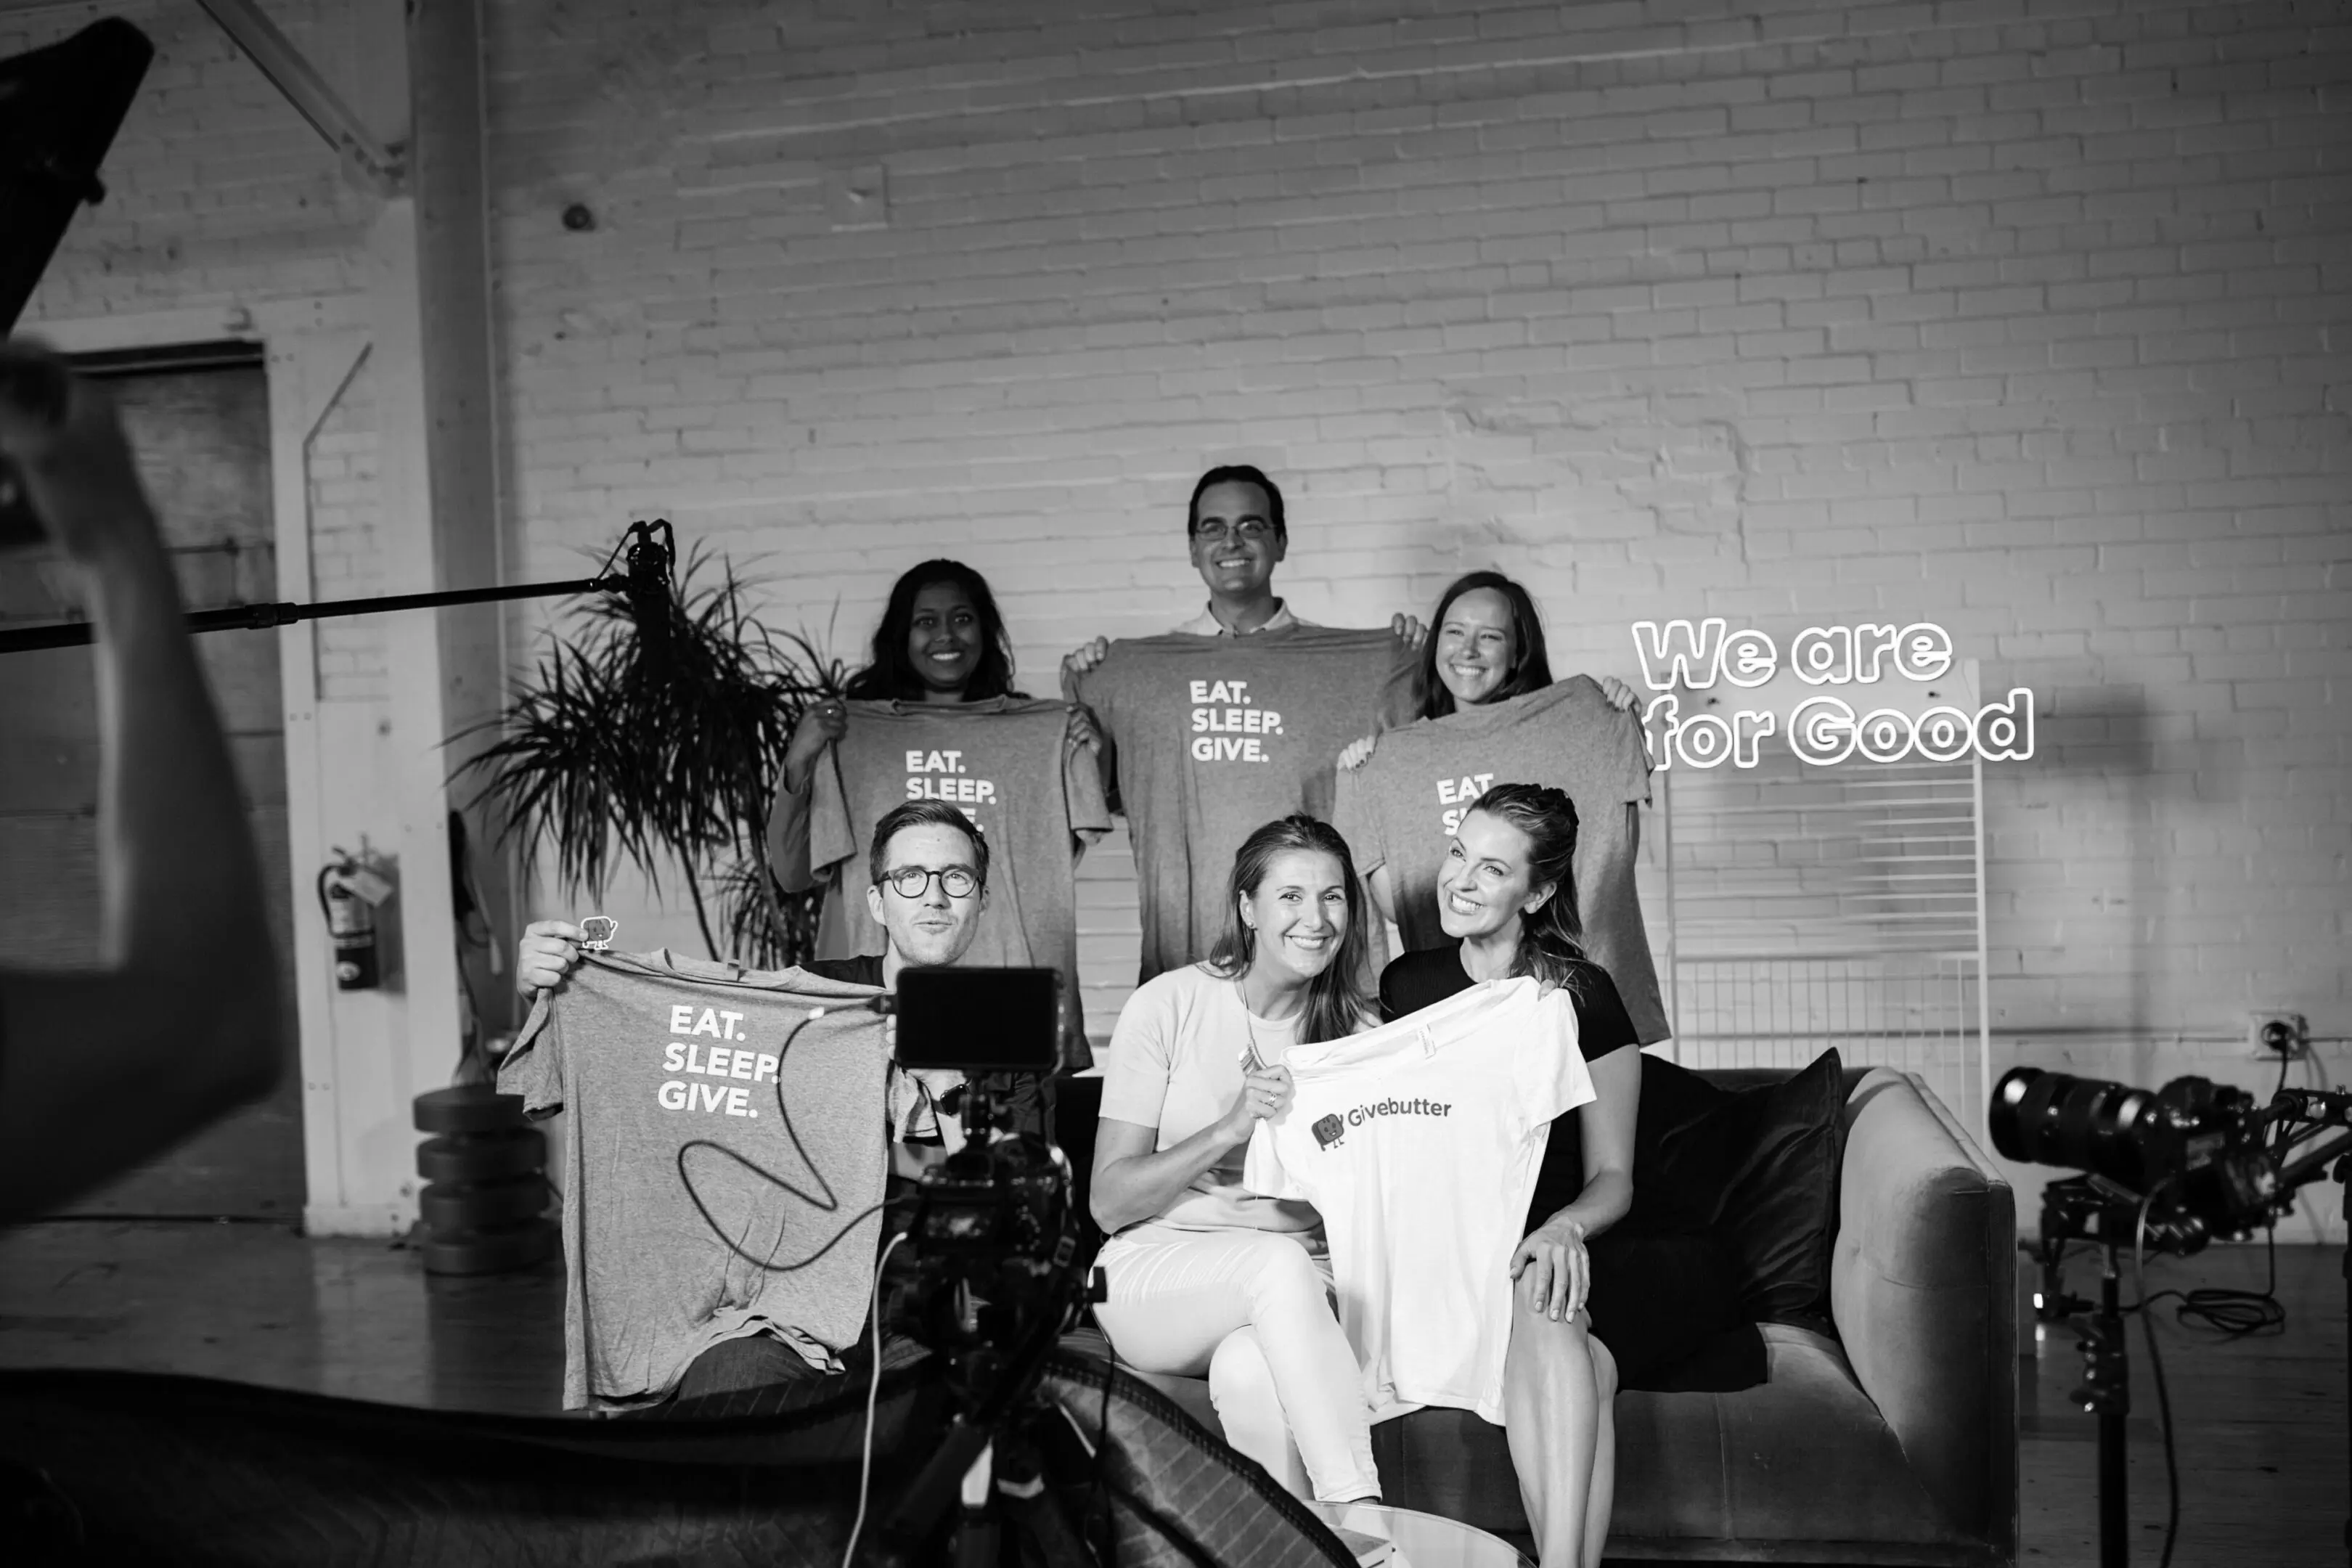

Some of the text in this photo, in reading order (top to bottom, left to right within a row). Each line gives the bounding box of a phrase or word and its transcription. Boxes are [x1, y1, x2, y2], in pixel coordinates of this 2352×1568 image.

[1631, 618, 1953, 690] We are
[1189, 680, 1251, 705] EAT.
[1191, 708, 1284, 735] SLEEP.
[1640, 687, 2035, 772] for Good
[905, 750, 966, 774] EAT.
[1191, 736, 1270, 763] GIVE.
[905, 777, 997, 805] SLEEP.
[669, 1004, 746, 1042] EAT.
[662, 1042, 782, 1085] SLEEP.
[658, 1080, 759, 1119] GIVE.
[1347, 1097, 1453, 1127] Givebutter
